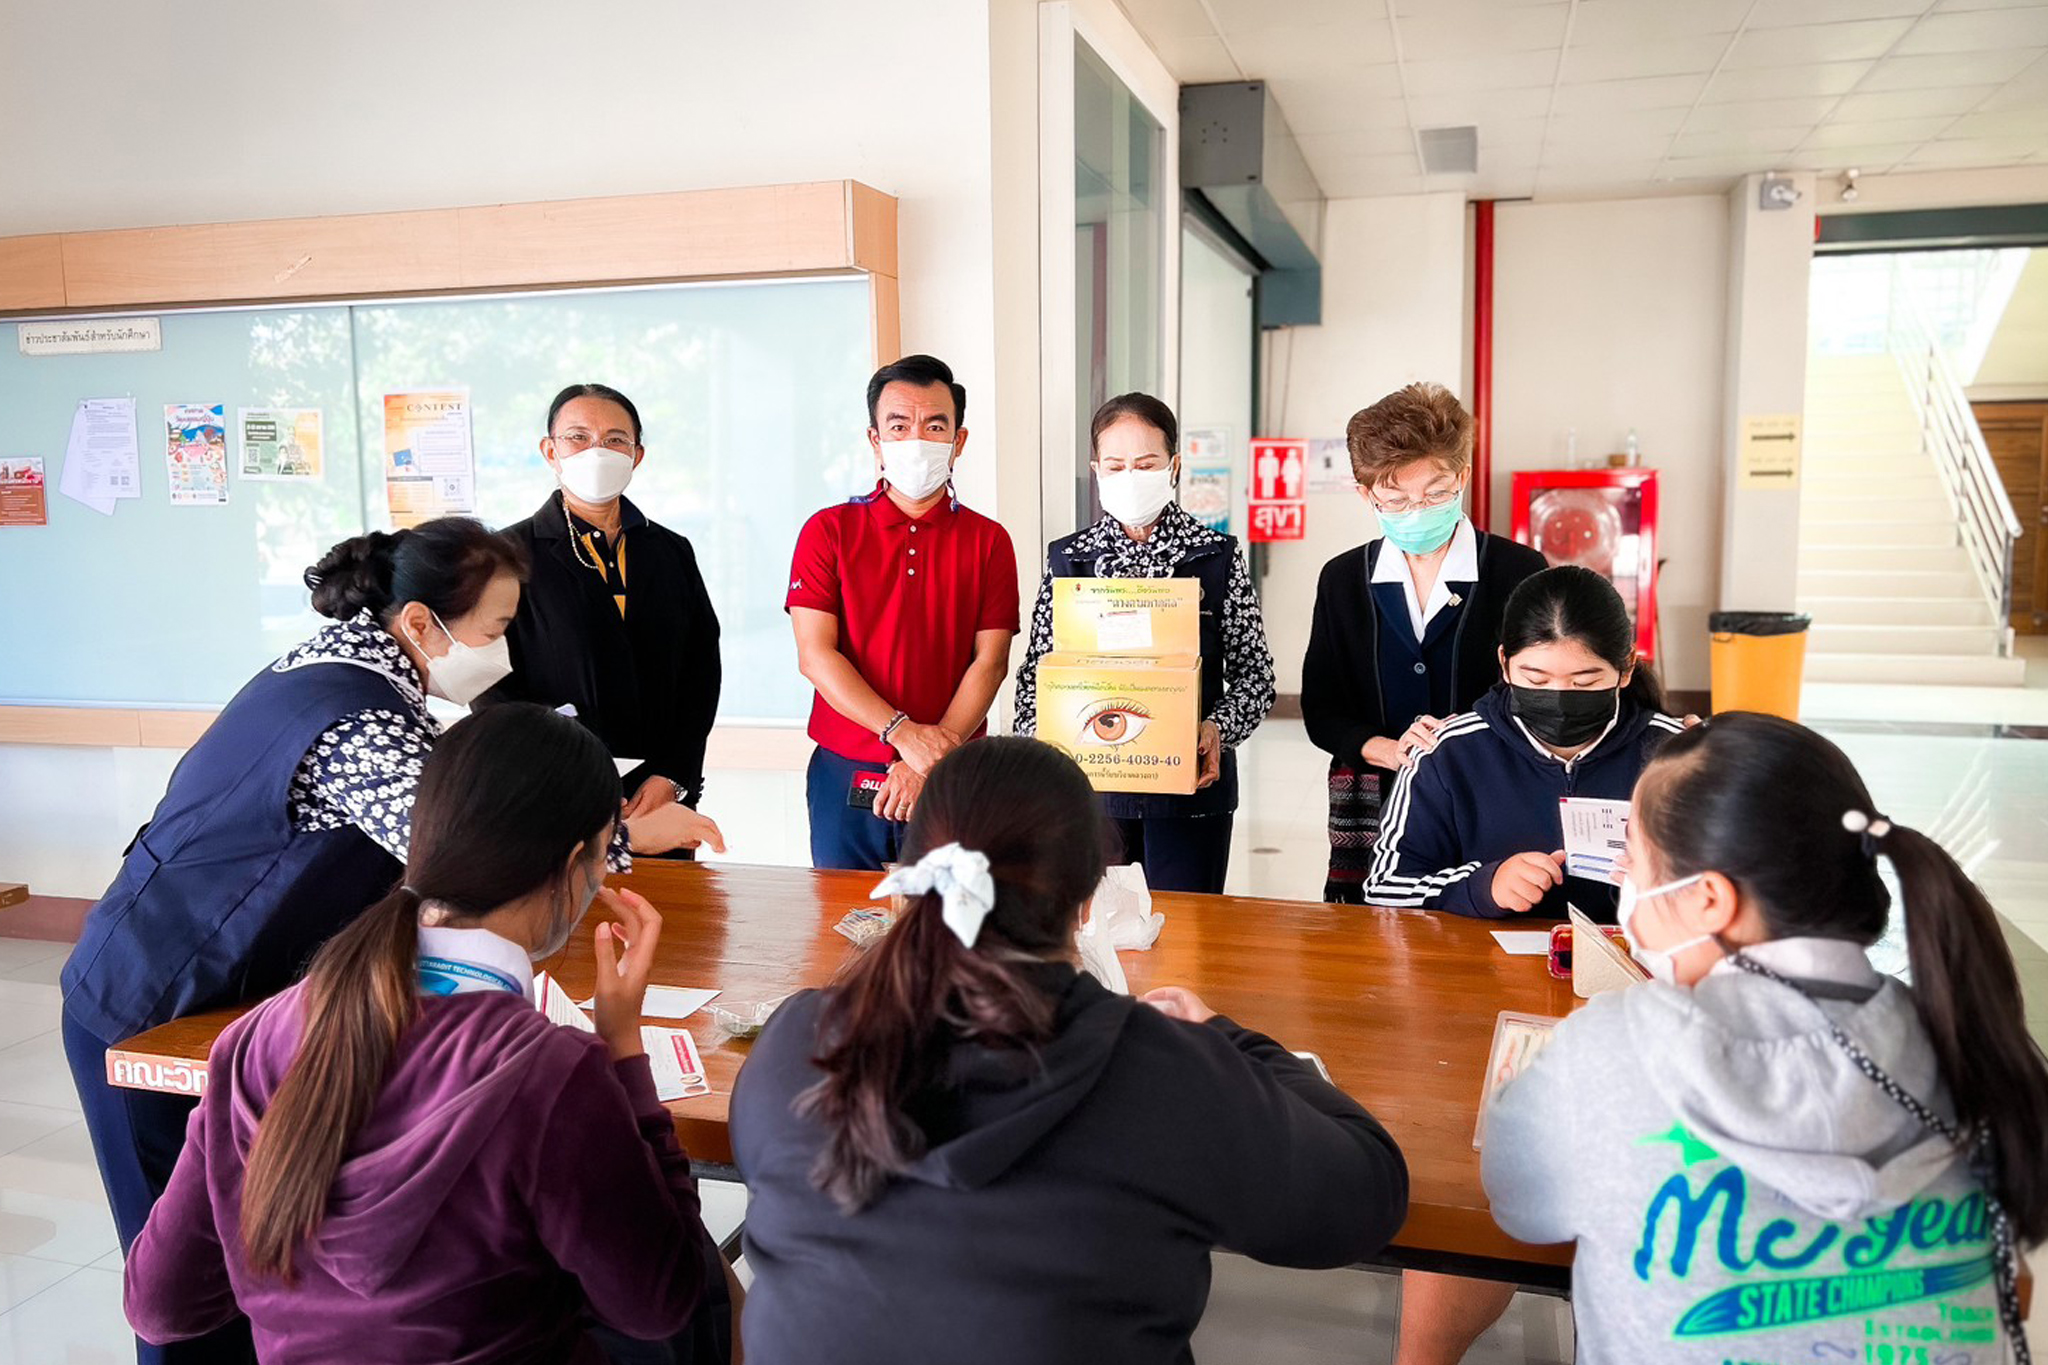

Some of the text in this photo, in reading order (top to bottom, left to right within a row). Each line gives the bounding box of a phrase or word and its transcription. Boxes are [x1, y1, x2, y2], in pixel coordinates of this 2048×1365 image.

[1254, 506, 1301, 537] สุขา
[1075, 753, 1181, 766] 0-2256-4039-40
[113, 1059, 209, 1094] คณะวิท
[1736, 1281, 1822, 1328] STATE
[1827, 1269, 1926, 1313] CHAMPIONS
